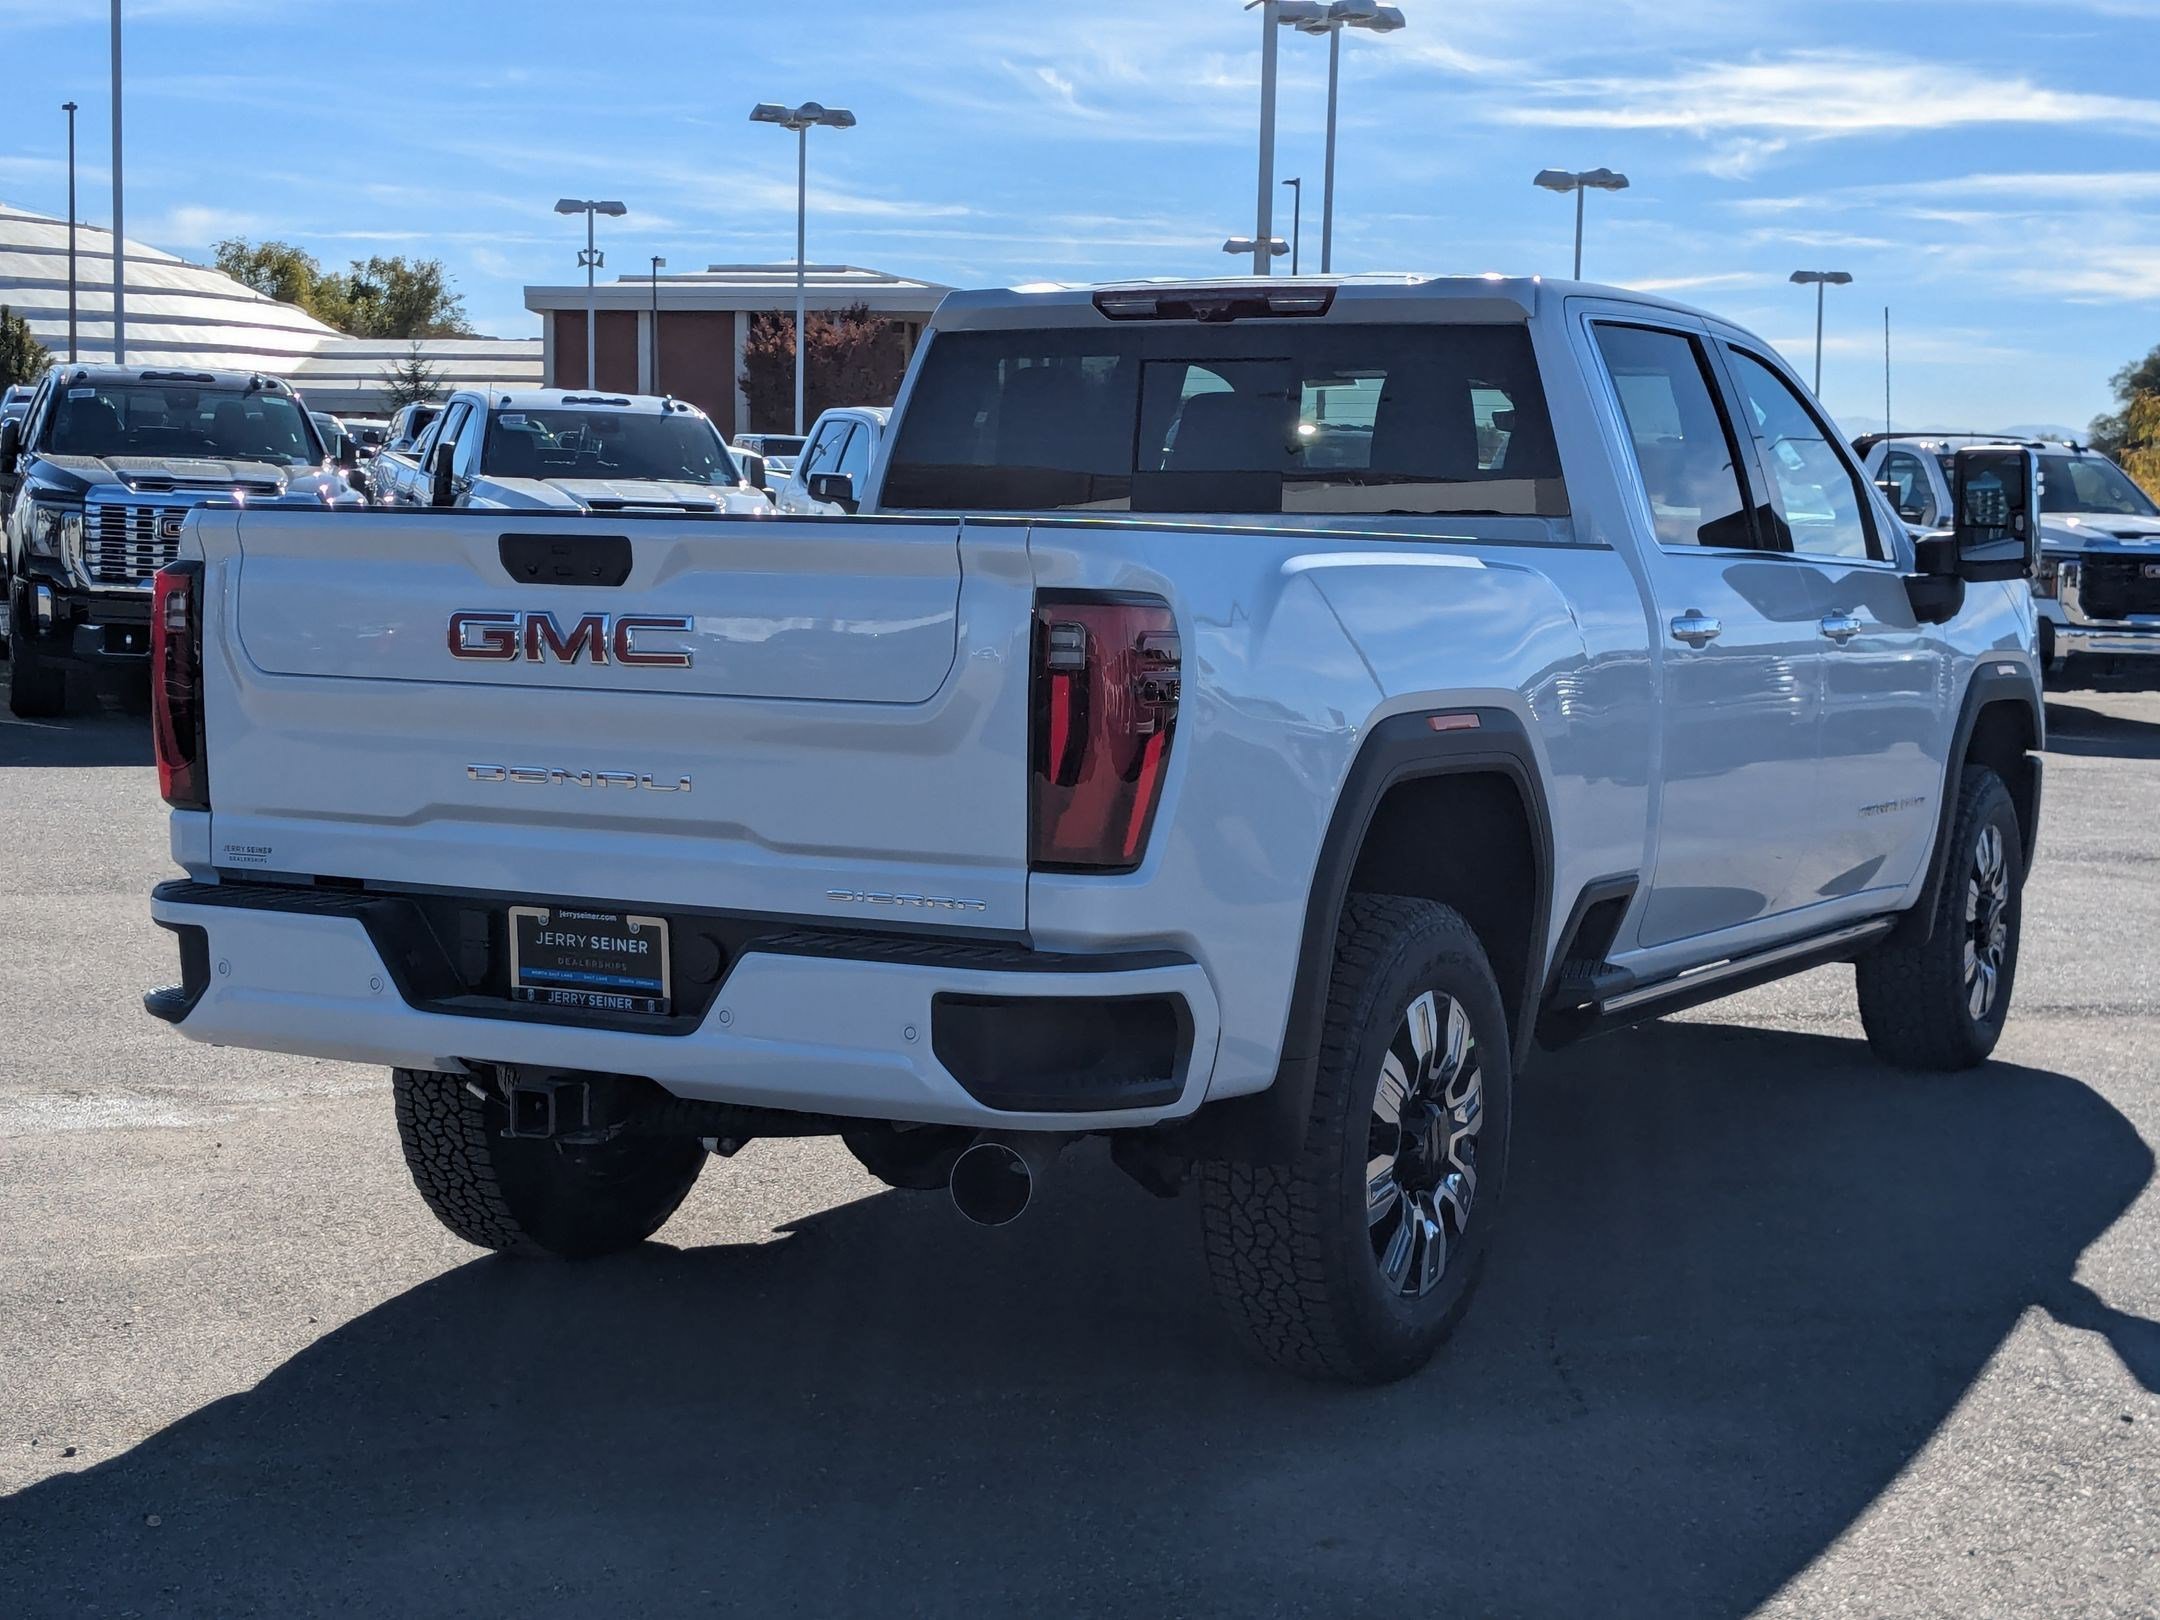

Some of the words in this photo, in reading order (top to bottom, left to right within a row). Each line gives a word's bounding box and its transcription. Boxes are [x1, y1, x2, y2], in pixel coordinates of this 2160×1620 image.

[448, 609, 694, 668] GMC
[466, 763, 692, 793] DENALI
[224, 844, 245, 853] JERRY
[246, 846, 273, 854] SEINER
[826, 888, 987, 912] SIERRA
[559, 909, 618, 922] jerryseiner.com
[536, 932, 587, 948] JERRY
[590, 936, 649, 954] SEINER
[557, 957, 628, 972] DEALERSHIPS
[548, 991, 586, 1005] JERRY
[588, 995, 633, 1010] SEINER
